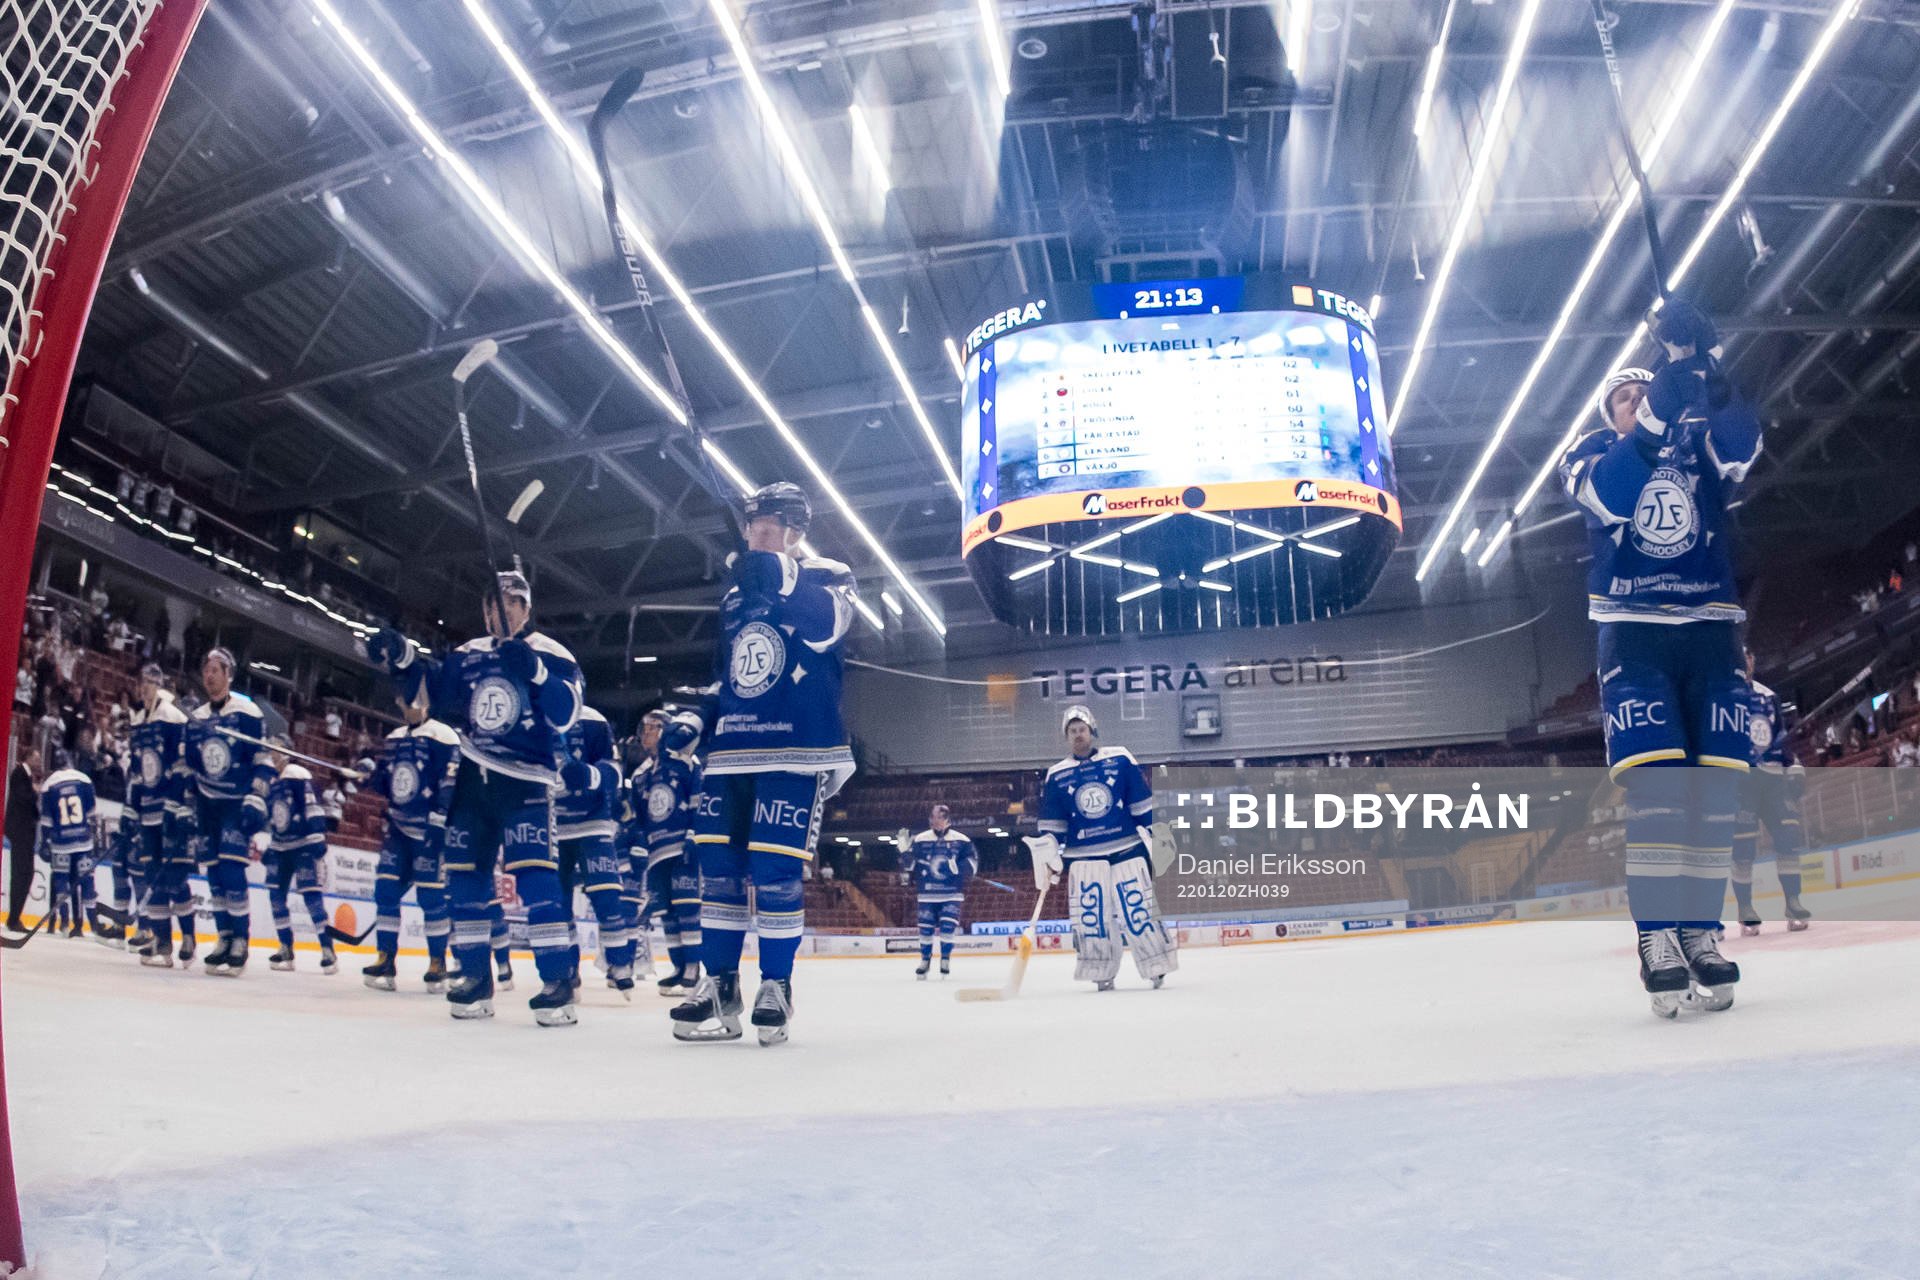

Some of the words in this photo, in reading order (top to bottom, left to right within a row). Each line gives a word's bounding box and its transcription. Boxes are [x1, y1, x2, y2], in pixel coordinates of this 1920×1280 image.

[1134, 287, 1203, 309] 21:13
[966, 301, 1043, 353] TEGERA
[1084, 495, 1180, 514] MaserFrakt
[1032, 662, 1209, 698] TEGERA
[1224, 654, 1348, 689] arena
[1606, 699, 1667, 739] INTEC
[58, 794, 84, 826] 13
[753, 798, 809, 829] INTEC
[504, 822, 549, 846] INTEC
[1081, 880, 1107, 939] LOGS
[1116, 876, 1155, 937] LOGS
